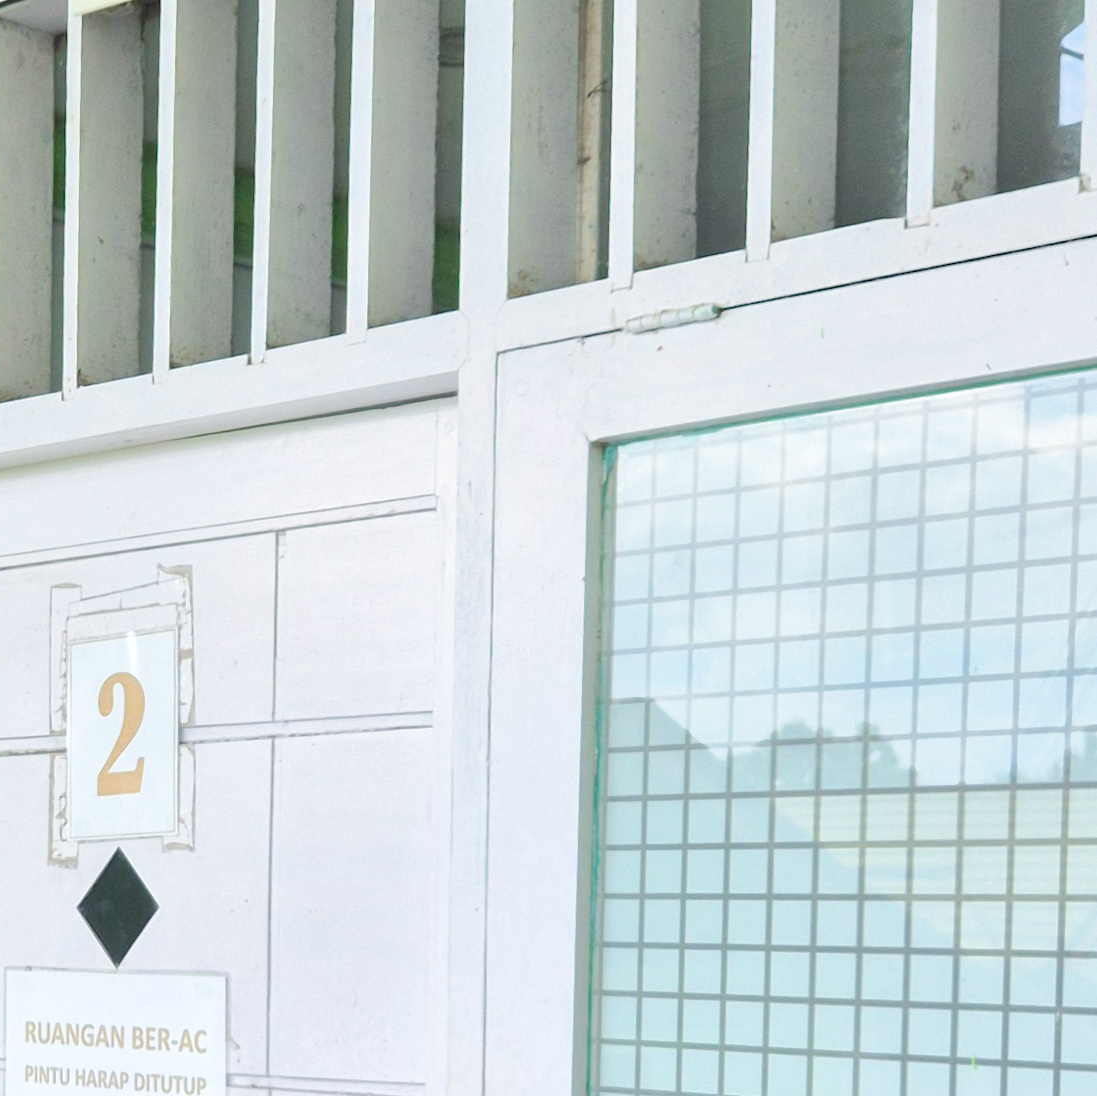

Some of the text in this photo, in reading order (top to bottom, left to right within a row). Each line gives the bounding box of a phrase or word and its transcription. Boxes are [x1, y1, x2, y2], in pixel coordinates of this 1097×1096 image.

[97, 671, 145, 796] 2
[25, 1020, 207, 1054] RUANGAN BER-AC
[24, 1064, 207, 1096] PINTU HARAP DITUTUP
